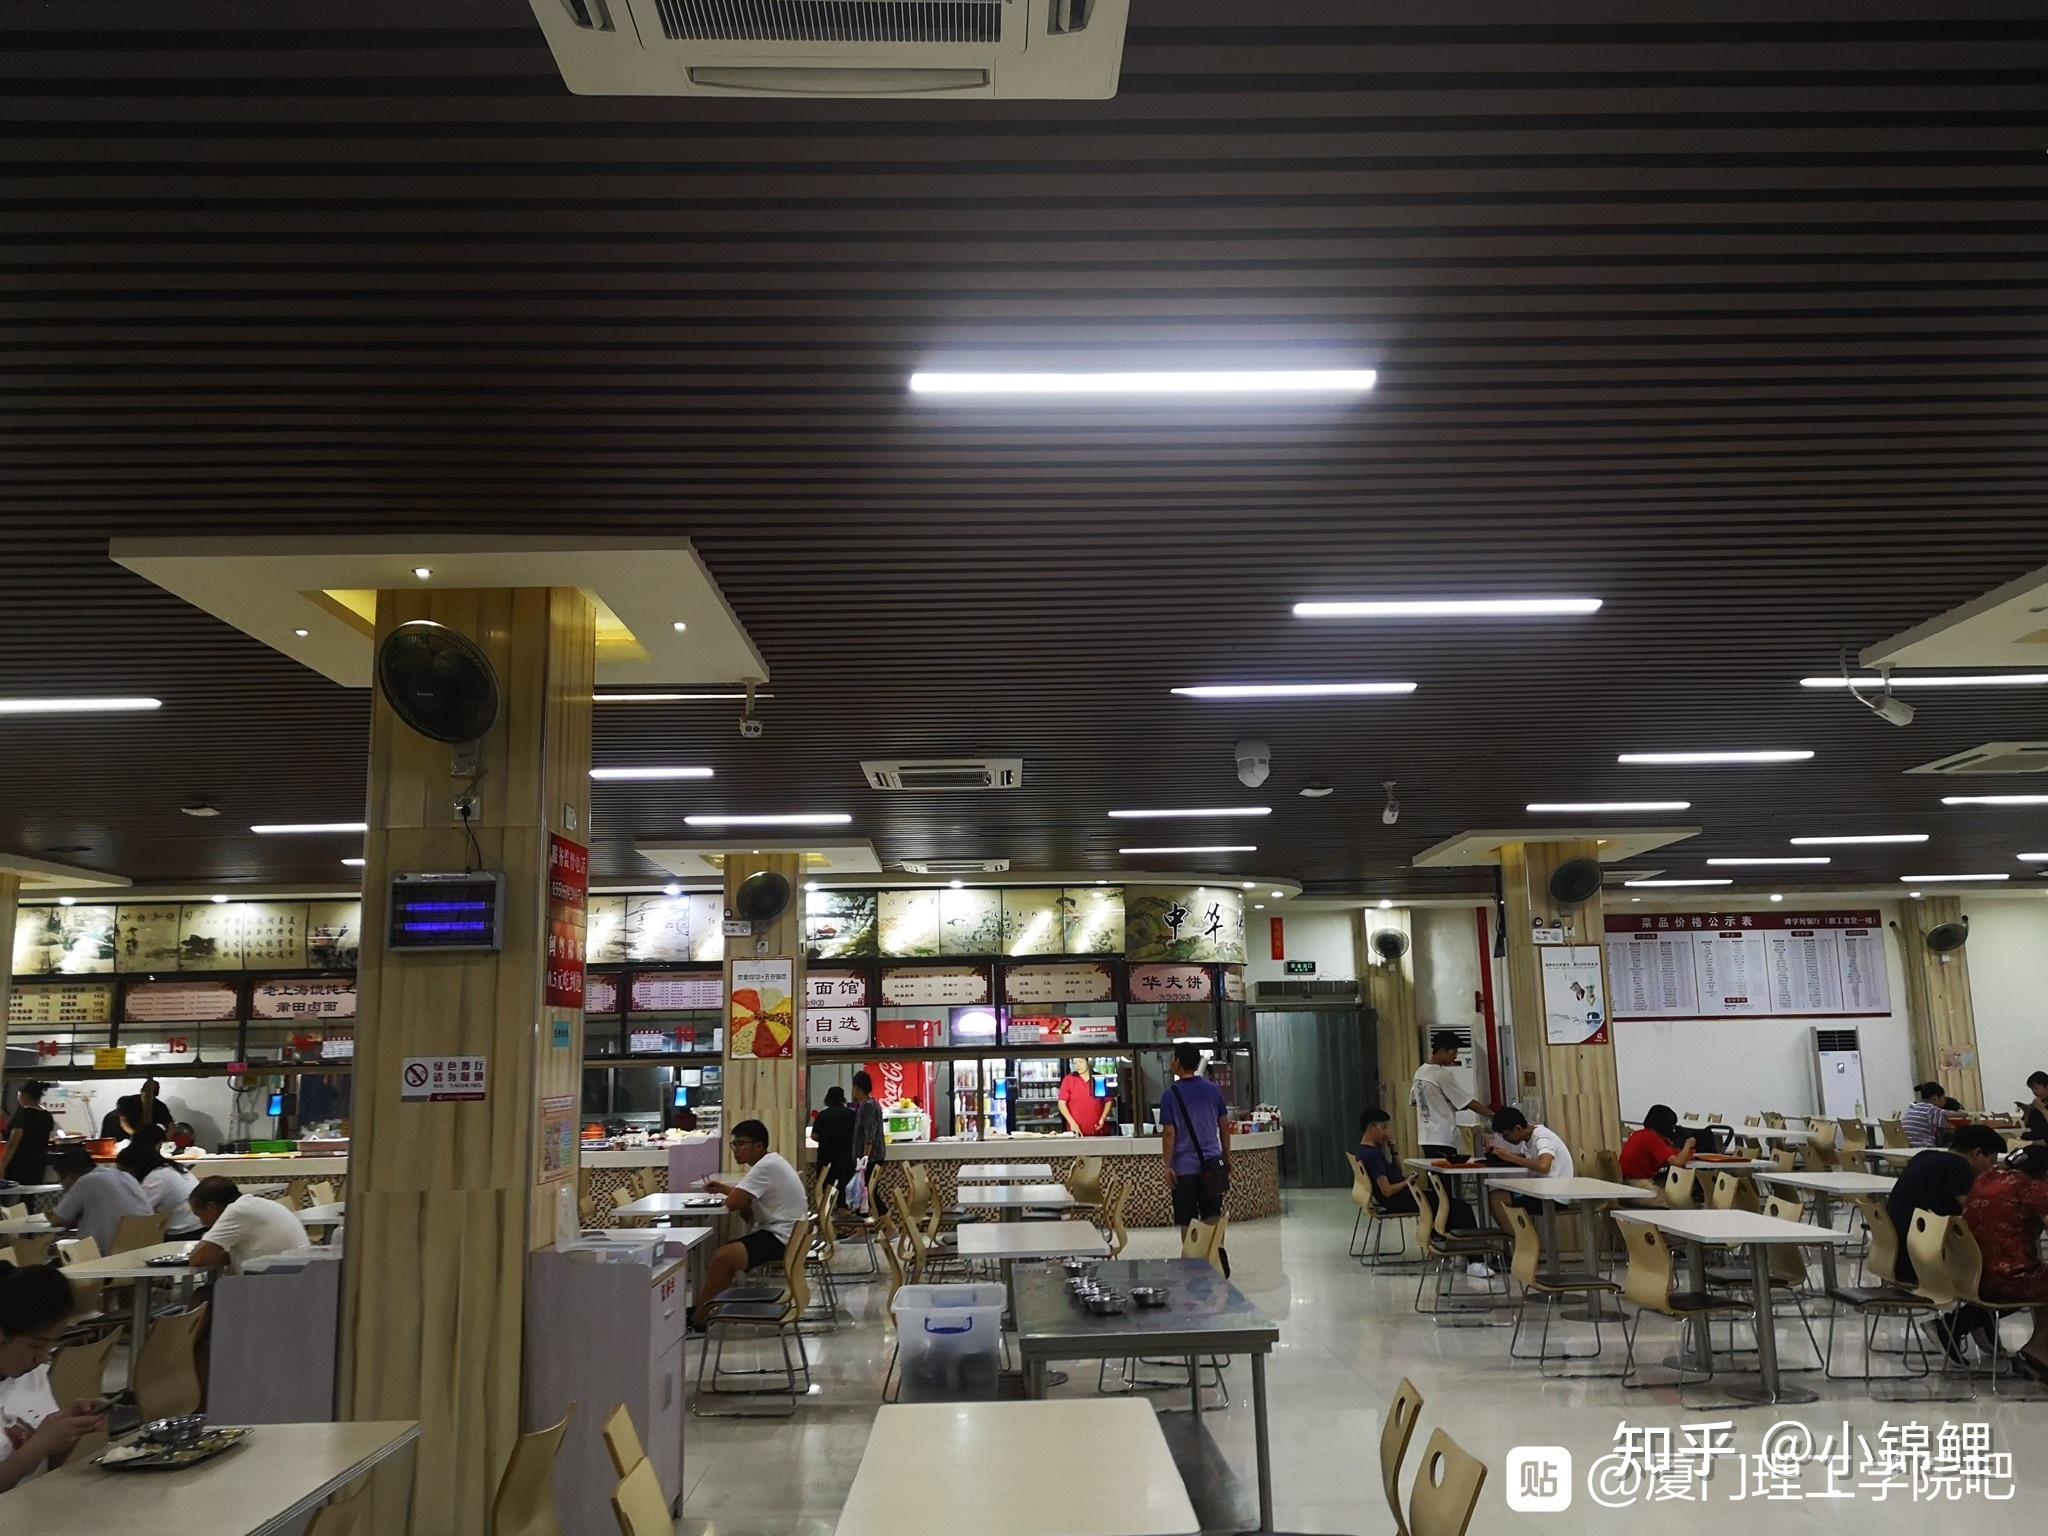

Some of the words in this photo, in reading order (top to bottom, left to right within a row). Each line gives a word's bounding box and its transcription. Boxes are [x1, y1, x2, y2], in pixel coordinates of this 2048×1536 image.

[1163, 902, 1244, 943] 中华
[1641, 915, 1753, 928] 菜品价格公示表
[262, 984, 356, 996] 老上海馄饨王
[806, 980, 860, 996] 面馆
[1142, 976, 1203, 990] 华夫饼
[806, 1016, 861, 1033] 自选
[1048, 1018, 1073, 1035] 22
[1166, 1018, 1190, 1034] 23
[168, 1037, 188, 1054] 15
